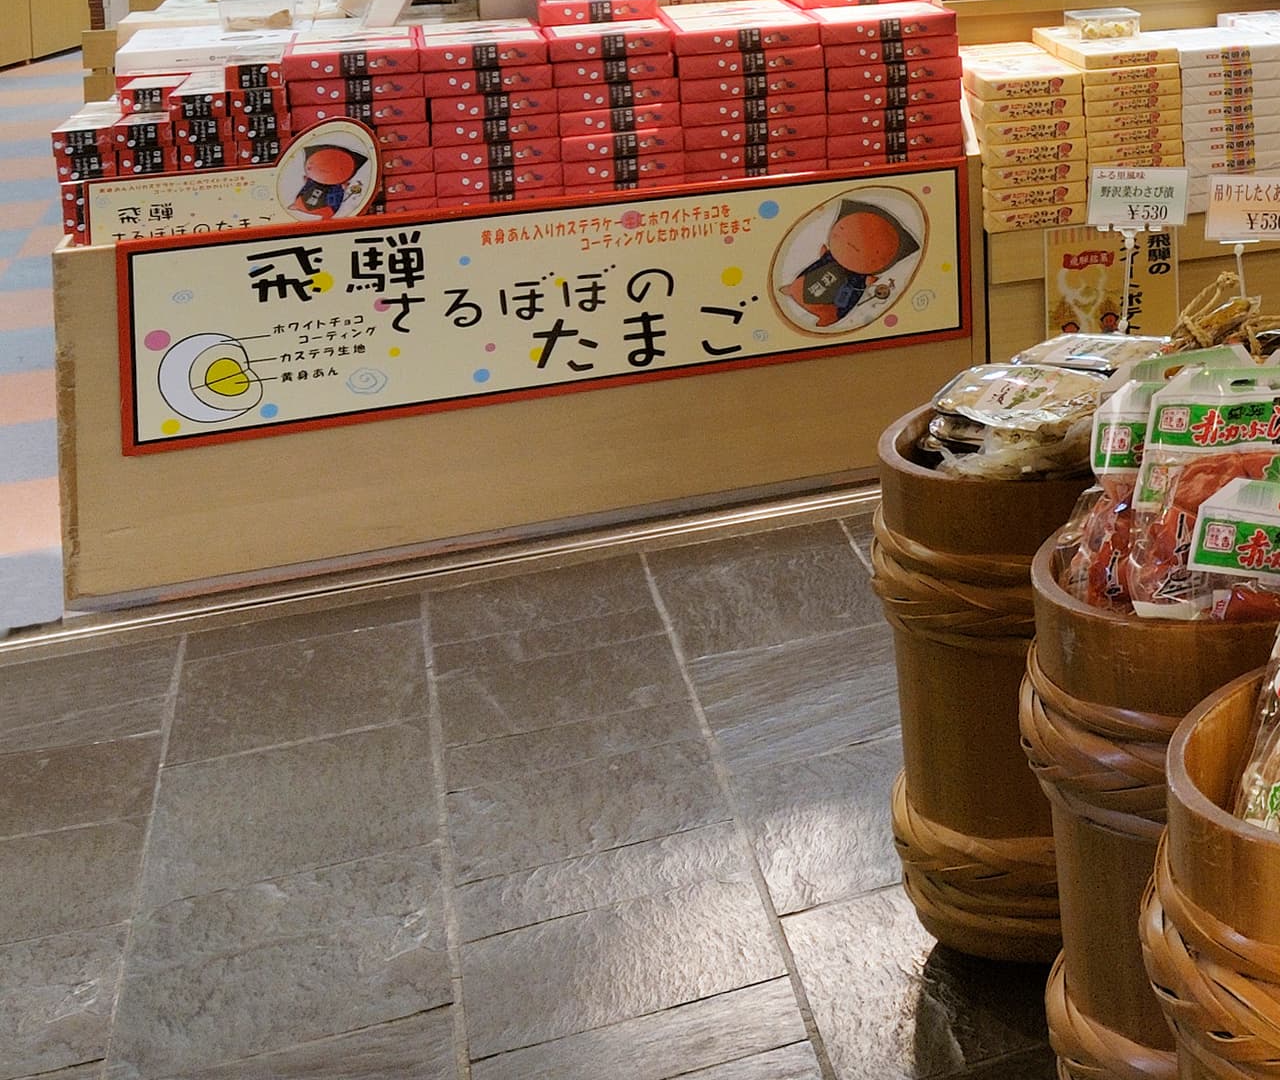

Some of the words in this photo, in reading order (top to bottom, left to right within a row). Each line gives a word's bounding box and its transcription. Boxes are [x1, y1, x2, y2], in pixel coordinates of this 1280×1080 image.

[1097, 170, 1146, 180] ふる里風味
[1100, 185, 1175, 200] 野沢菜わさび漬
[1147, 234, 1171, 275] 飛騨の
[246, 231, 426, 304] 飛騨
[381, 265, 674, 334] さるぼぼの
[272, 314, 366, 335] ホワイトチョコ
[532, 295, 760, 373] たまご
[298, 326, 377, 345] コーティング
[280, 344, 367, 363] カステラ生地
[280, 367, 339, 383] 黄身あん
